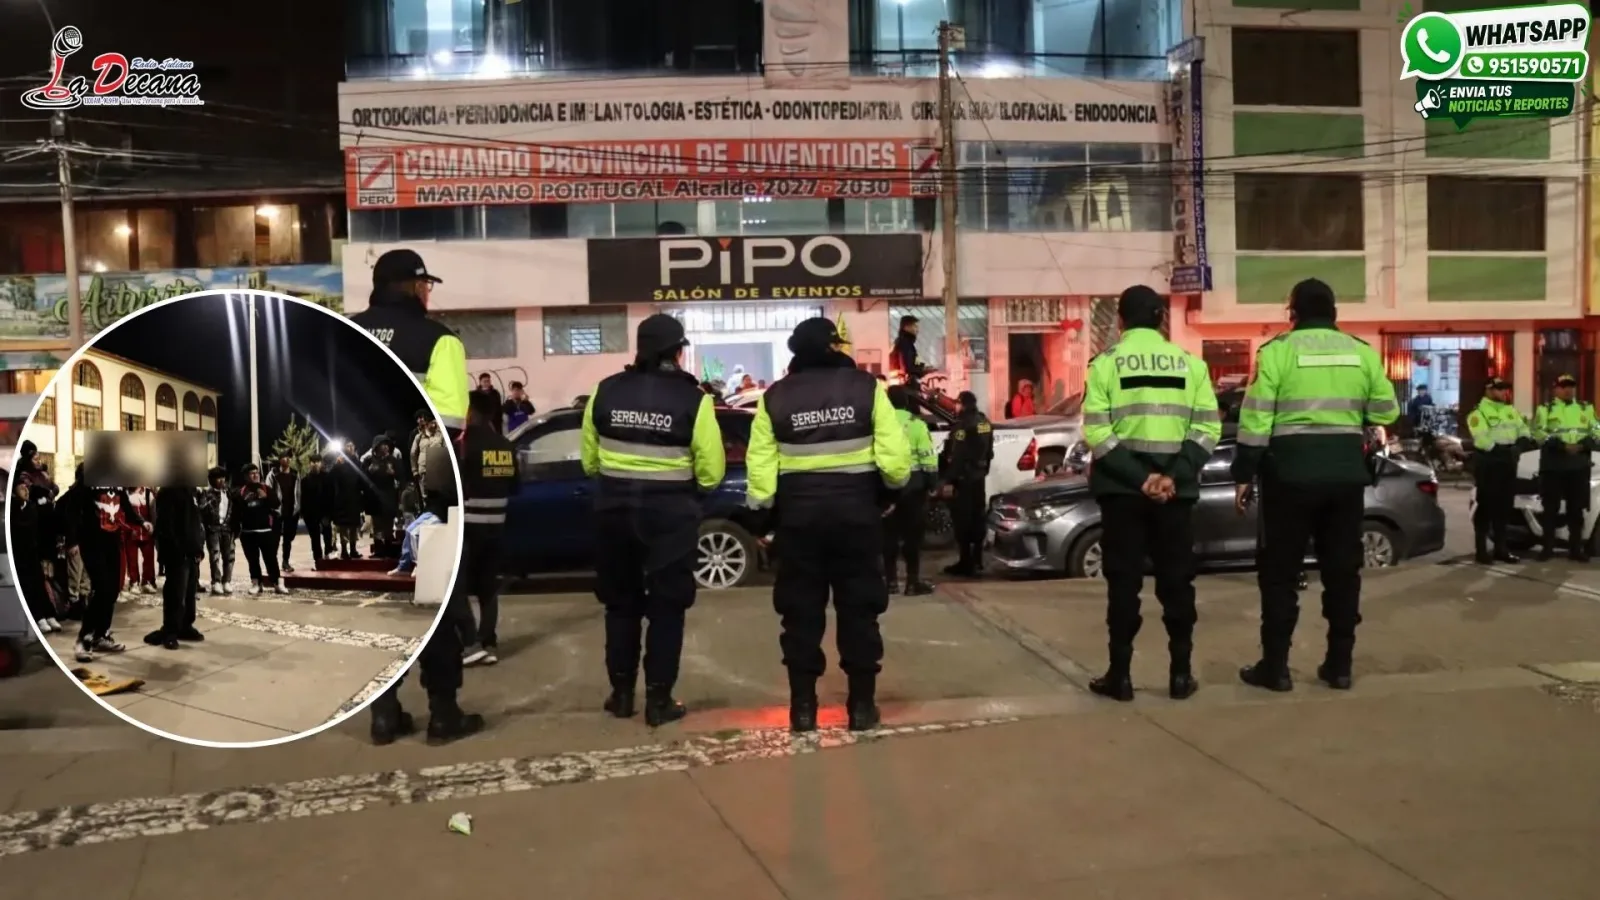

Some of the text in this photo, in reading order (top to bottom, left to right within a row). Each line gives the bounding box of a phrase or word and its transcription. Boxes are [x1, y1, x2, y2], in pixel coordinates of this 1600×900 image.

[352, 106, 448, 127] ORTODONCIA
[456, 102, 553, 125] PERIODONCIA
[557, 102, 566, 121] E
[570, 101, 686, 121] IMLANTOLOGIA
[695, 97, 763, 120] ESTÉTICA
[773, 101, 902, 121] ODONTOPEDIATRIA
[911, 101, 966, 121] CIRUIA
[1075, 104, 1158, 123] ENDODONCIA
[404, 142, 896, 180] COMANDO PROVINCIAL DE JUVENTUDES
[359, 196, 395, 204] PERU
[416, 184, 534, 203] MARIANO
[540, 181, 670, 200] PORTUGAL
[674, 180, 756, 197] Alcalde
[764, 179, 816, 196] 2027
[837, 179, 890, 196] 2030
[653, 286, 722, 300] SALÓN
[735, 287, 760, 298] DE
[772, 285, 862, 297] EVENTOS
[1115, 354, 1188, 373] POLICIA
[611, 410, 673, 428] SERENAZGO
[791, 406, 855, 427] SERENAZGO
